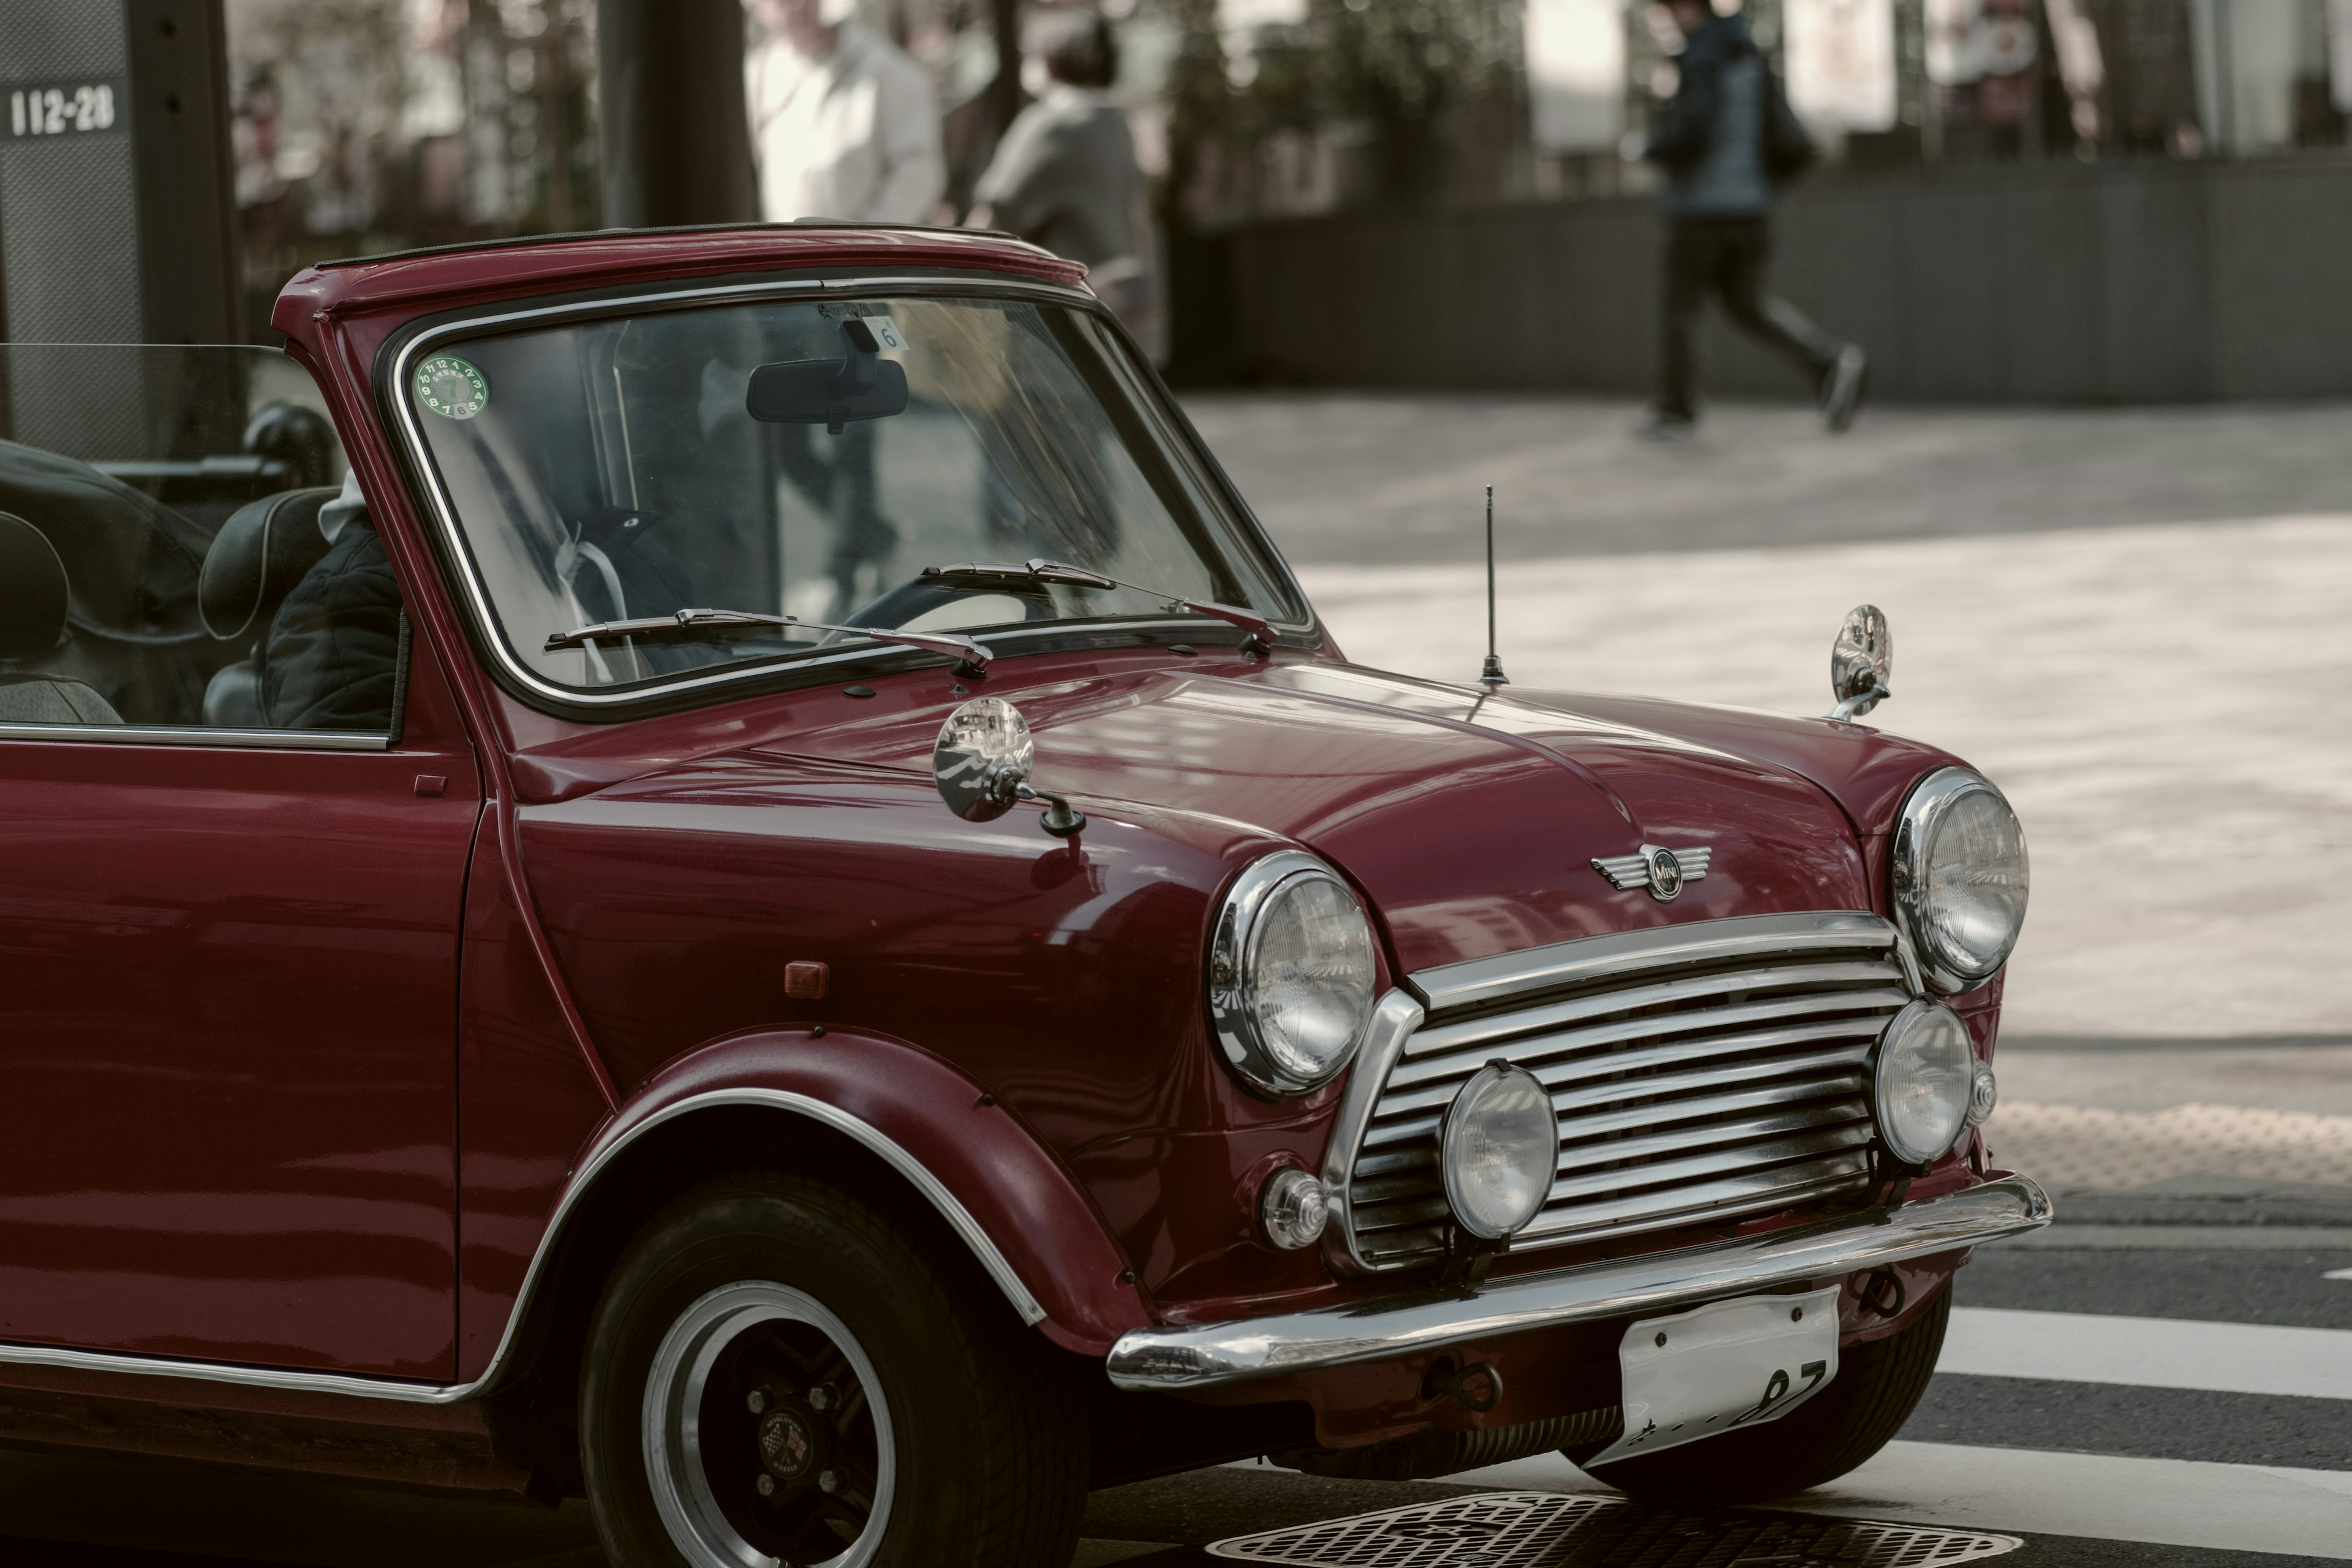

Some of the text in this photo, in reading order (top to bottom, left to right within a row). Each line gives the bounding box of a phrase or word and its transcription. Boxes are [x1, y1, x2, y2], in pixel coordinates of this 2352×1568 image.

[11, 84, 115, 136] 112-28
[881, 328, 897, 347] 6
[426, 364, 435, 372] 11
[436, 360, 448, 368] 12
[465, 368, 475, 377] 2
[419, 375, 430, 383] 10
[472, 380, 482, 388] 3
[421, 386, 431, 395] 9
[443, 379, 457, 399] 7
[429, 398, 439, 407] 8
[468, 402, 478, 410] 5
[442, 405, 450, 414] 7
[1655, 866, 1678, 880] MINI
[766, 1417, 802, 1433] REVOLUTION
